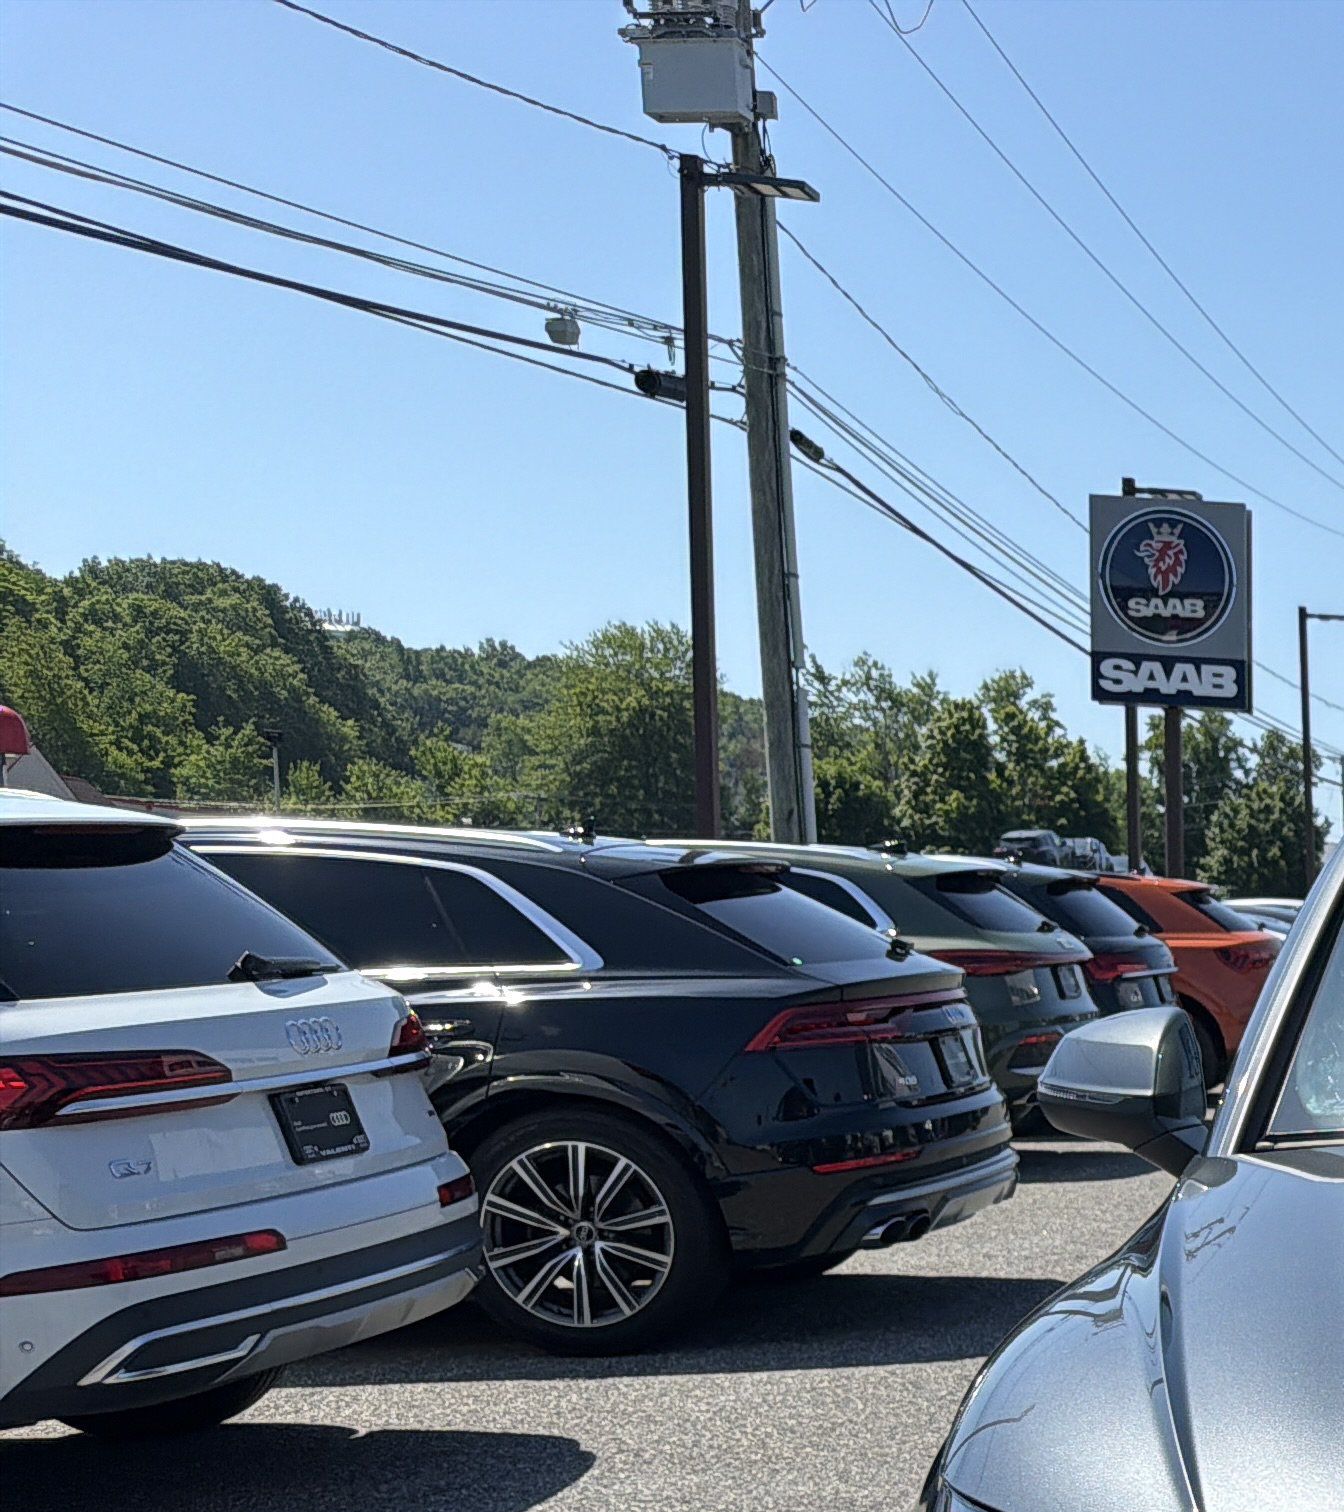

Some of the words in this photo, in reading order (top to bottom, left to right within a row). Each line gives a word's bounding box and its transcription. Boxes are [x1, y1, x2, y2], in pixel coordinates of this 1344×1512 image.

[1127, 597, 1206, 619] SAAB
[1098, 657, 1239, 698] SAAB
[109, 1159, 152, 1179] Q7
